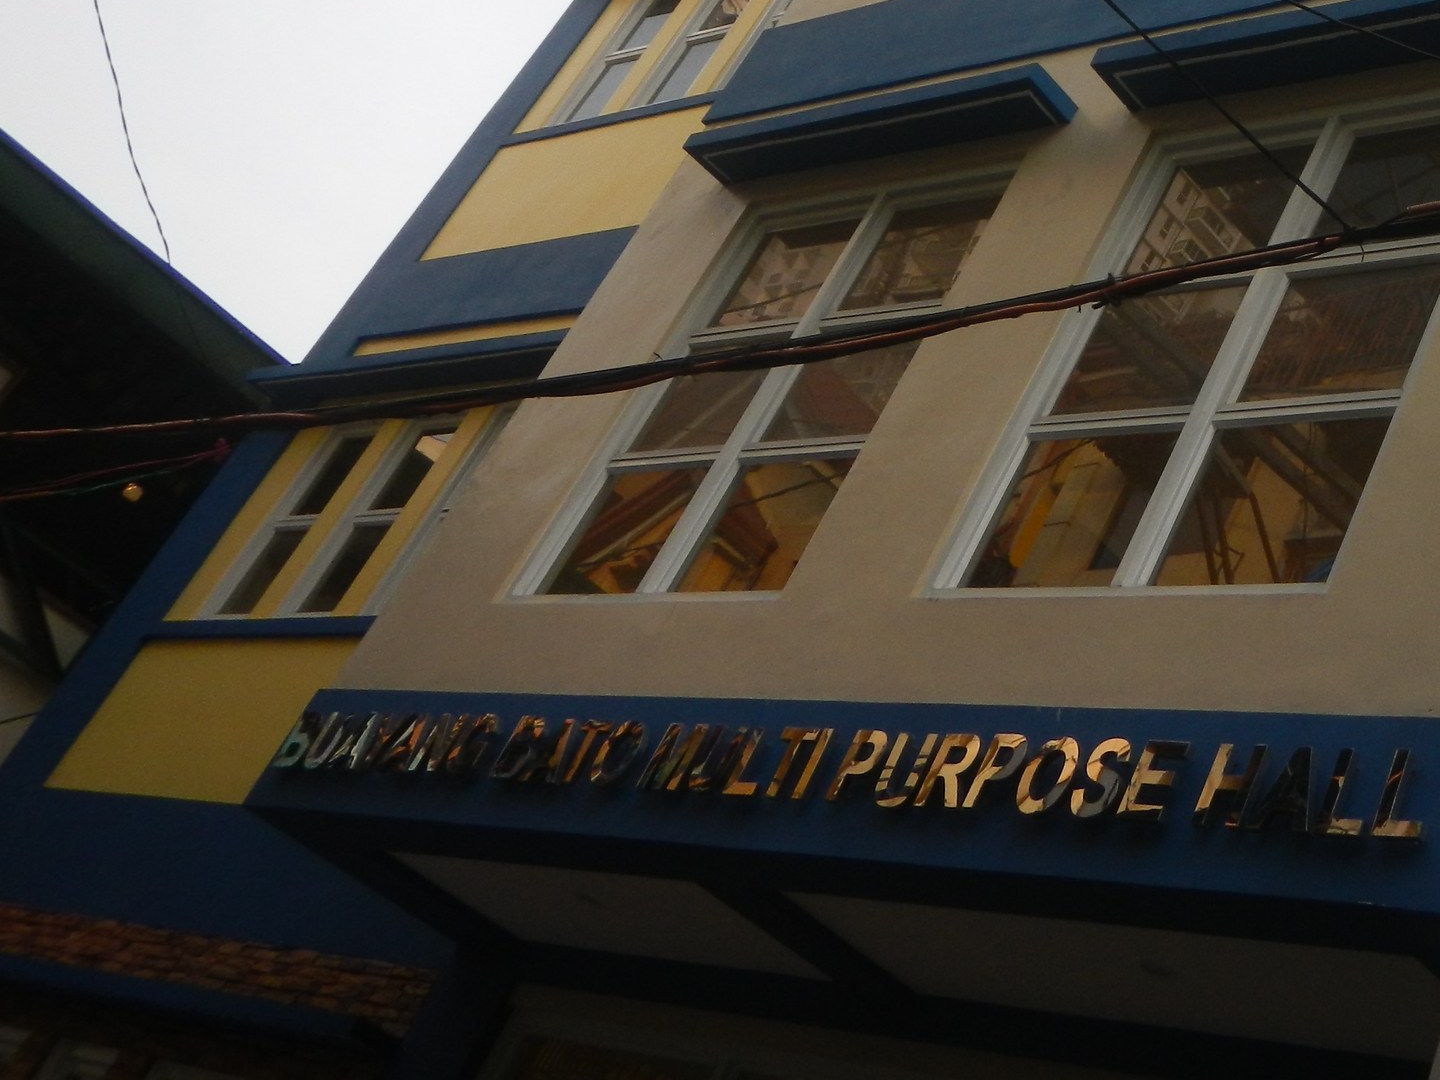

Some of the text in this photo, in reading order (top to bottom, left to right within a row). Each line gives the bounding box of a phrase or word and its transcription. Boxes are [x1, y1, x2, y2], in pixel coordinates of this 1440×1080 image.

[489, 714, 649, 785] BATO
[636, 722, 835, 800] MULTI
[825, 728, 1191, 821] PURPOSE
[1194, 743, 1423, 842] HALL
